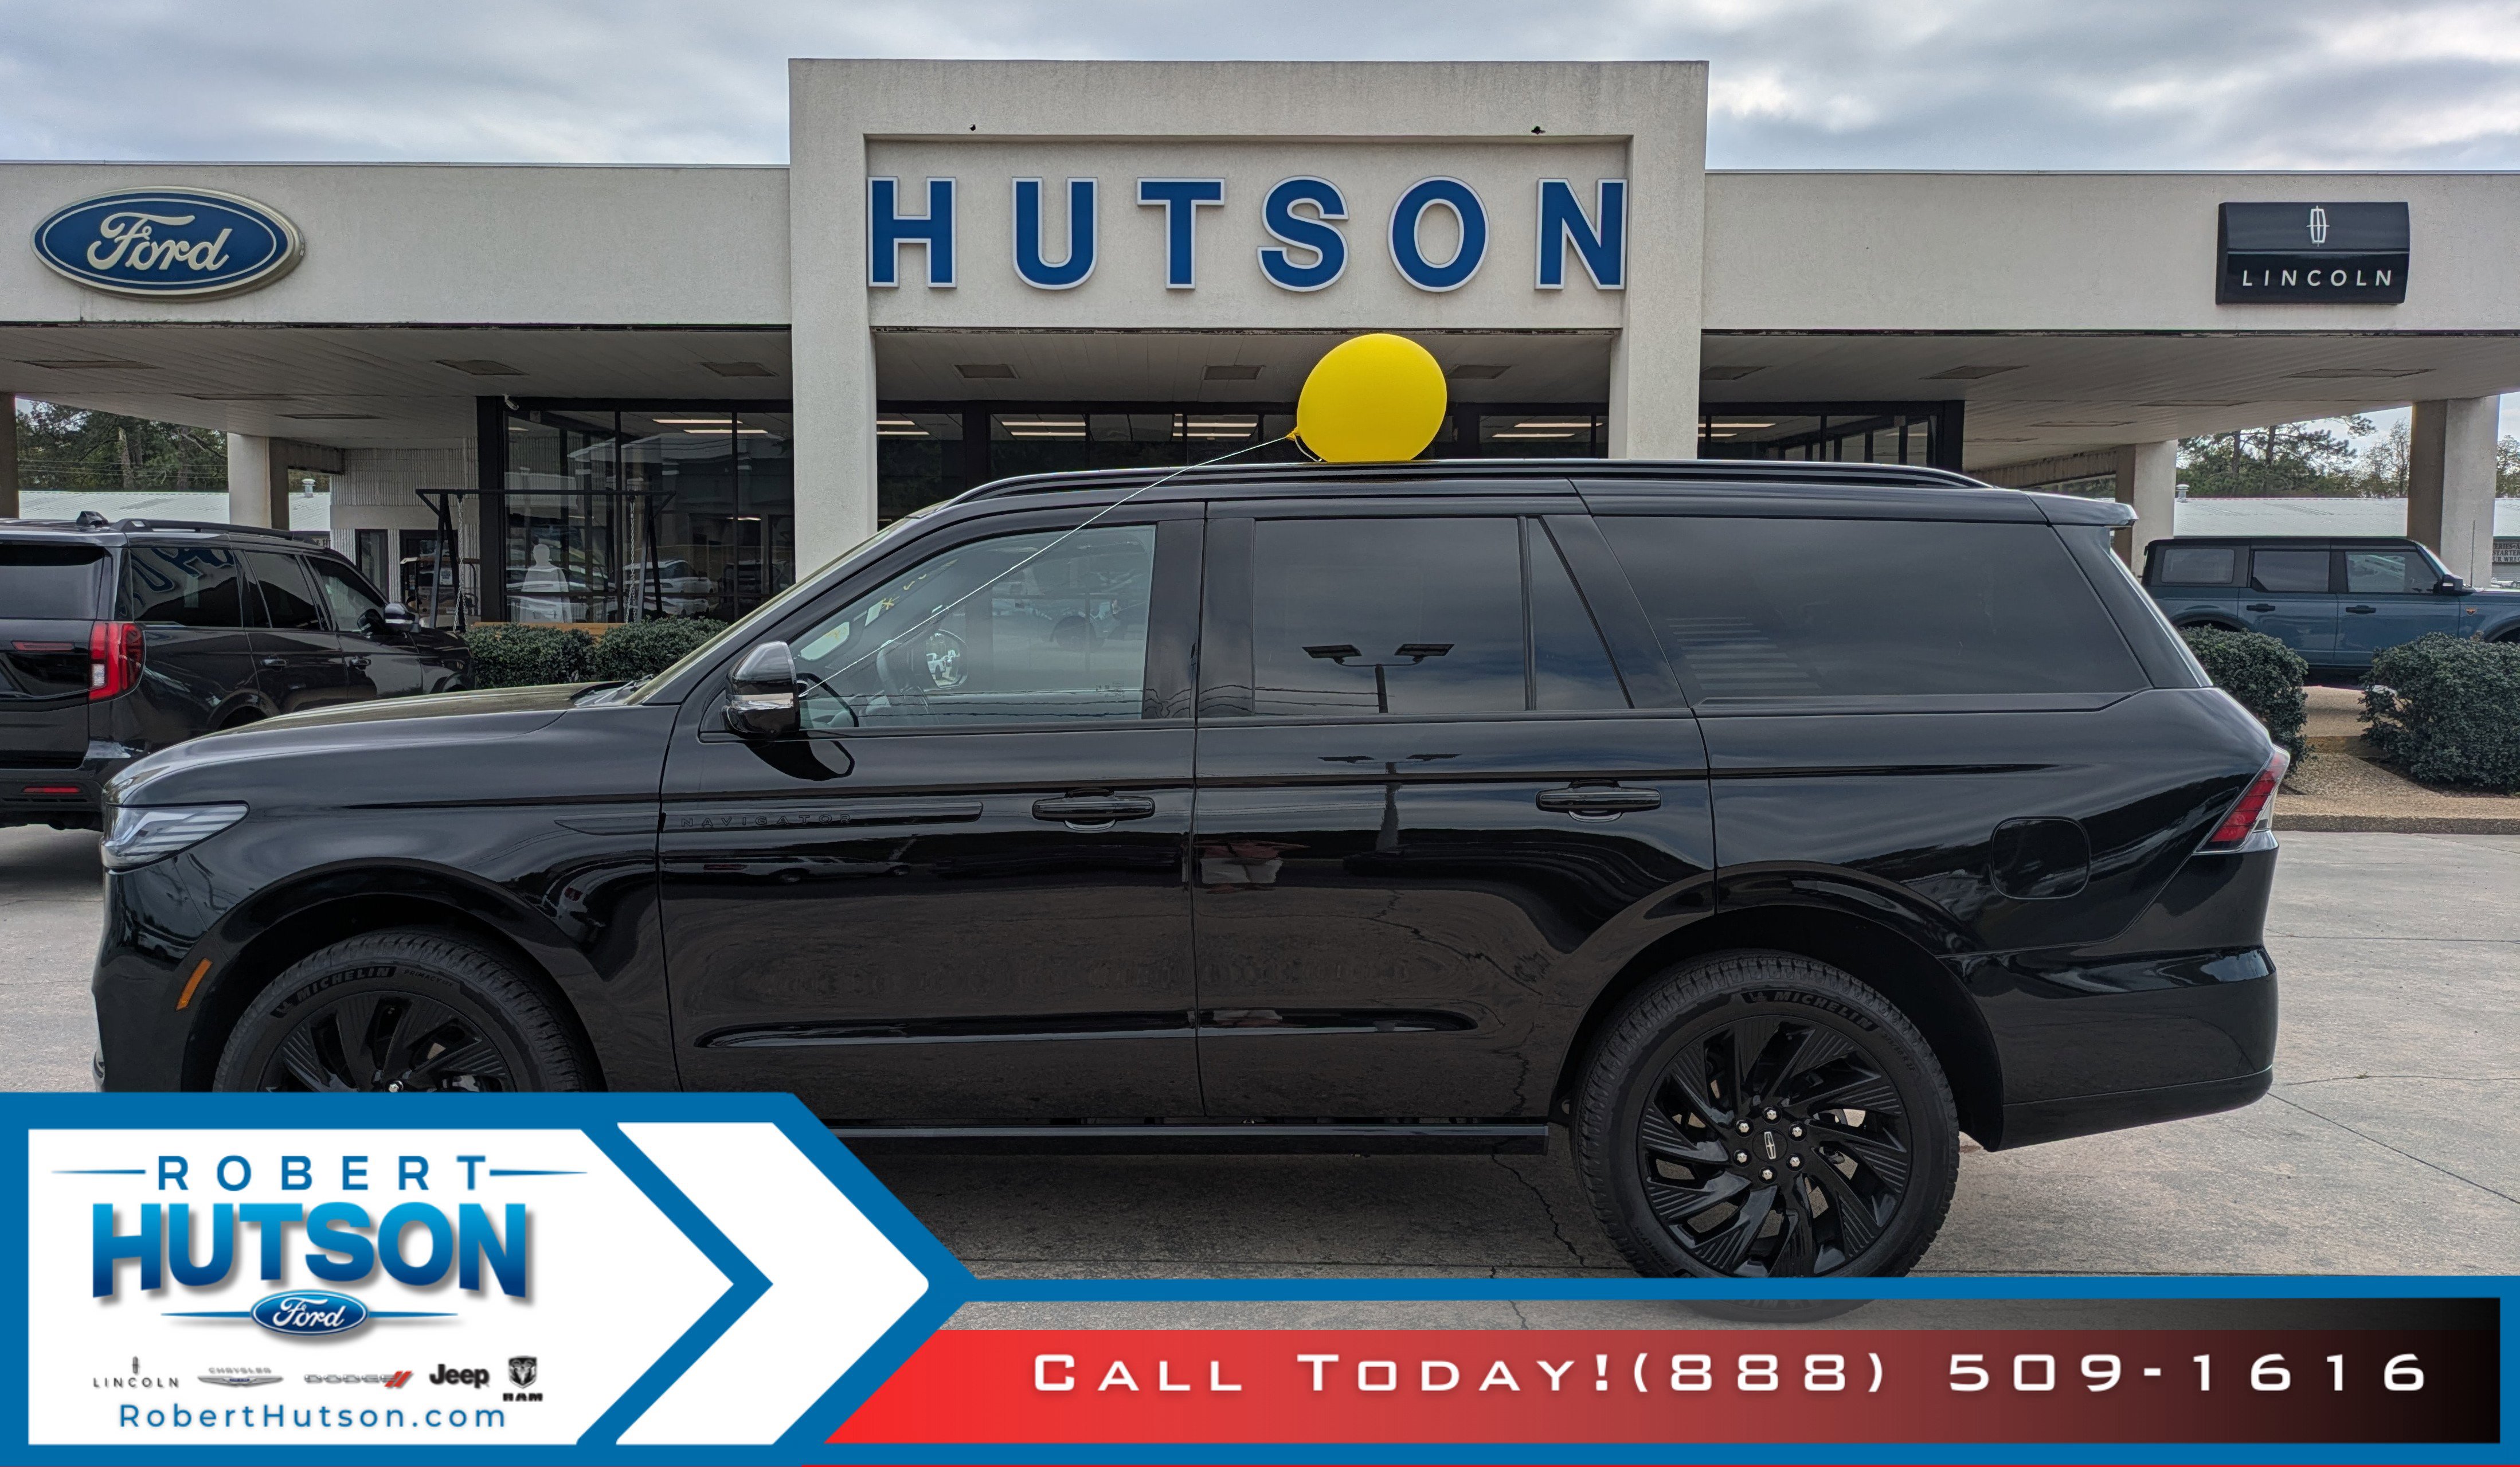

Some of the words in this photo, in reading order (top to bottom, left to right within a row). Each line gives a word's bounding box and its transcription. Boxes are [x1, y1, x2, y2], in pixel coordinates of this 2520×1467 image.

[87, 212, 233, 271] Ford
[867, 175, 1629, 292] HUTSON
[2242, 269, 2392, 287] LINCOLN
[681, 813, 851, 827] NAVIGATOR
[296, 966, 390, 1000] MICHELIN
[1774, 991, 1873, 1029] MICHELIN
